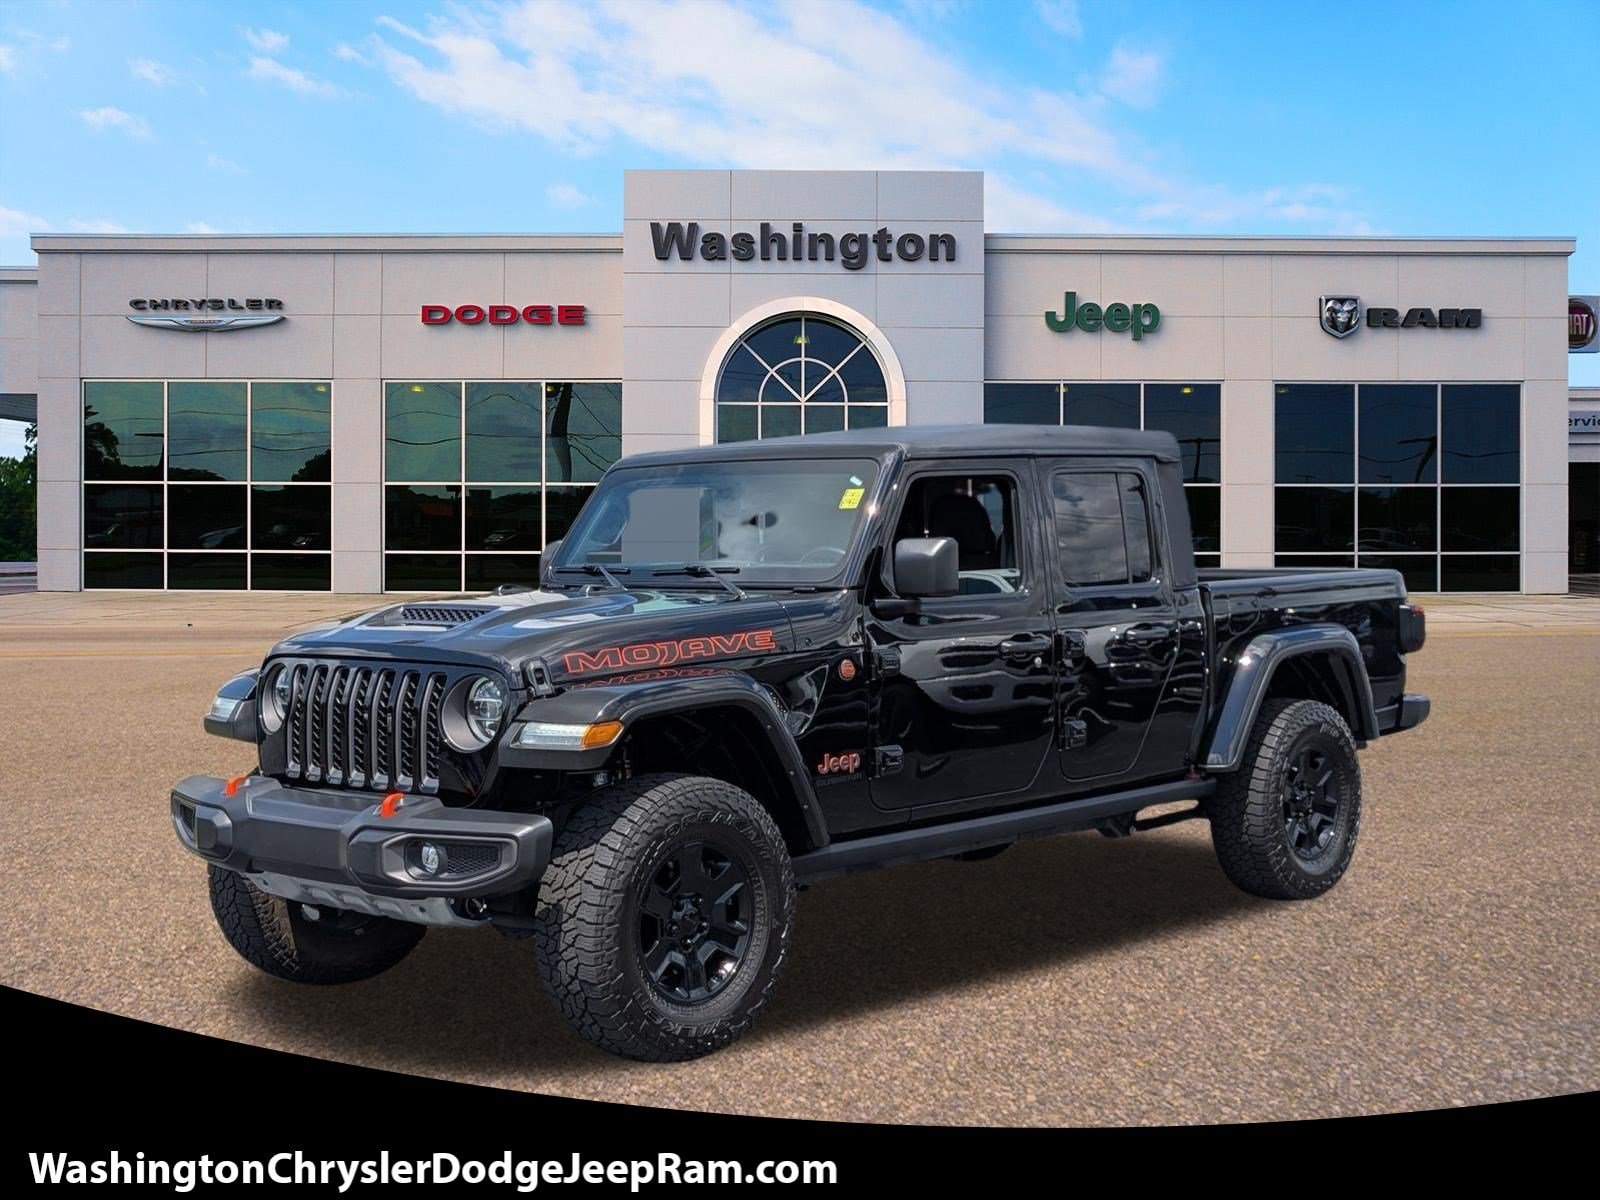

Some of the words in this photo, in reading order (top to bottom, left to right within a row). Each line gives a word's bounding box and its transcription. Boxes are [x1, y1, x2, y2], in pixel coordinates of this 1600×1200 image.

[650, 222, 957, 270] Washington
[129, 298, 285, 311] CHRYSLER
[421, 304, 587, 326] DODGE
[1044, 291, 1162, 341] Jeep
[1366, 307, 1483, 329] RAM
[1568, 313, 1589, 335] IAT
[562, 629, 777, 675] MOJAVE
[817, 752, 861, 775] Jeep
